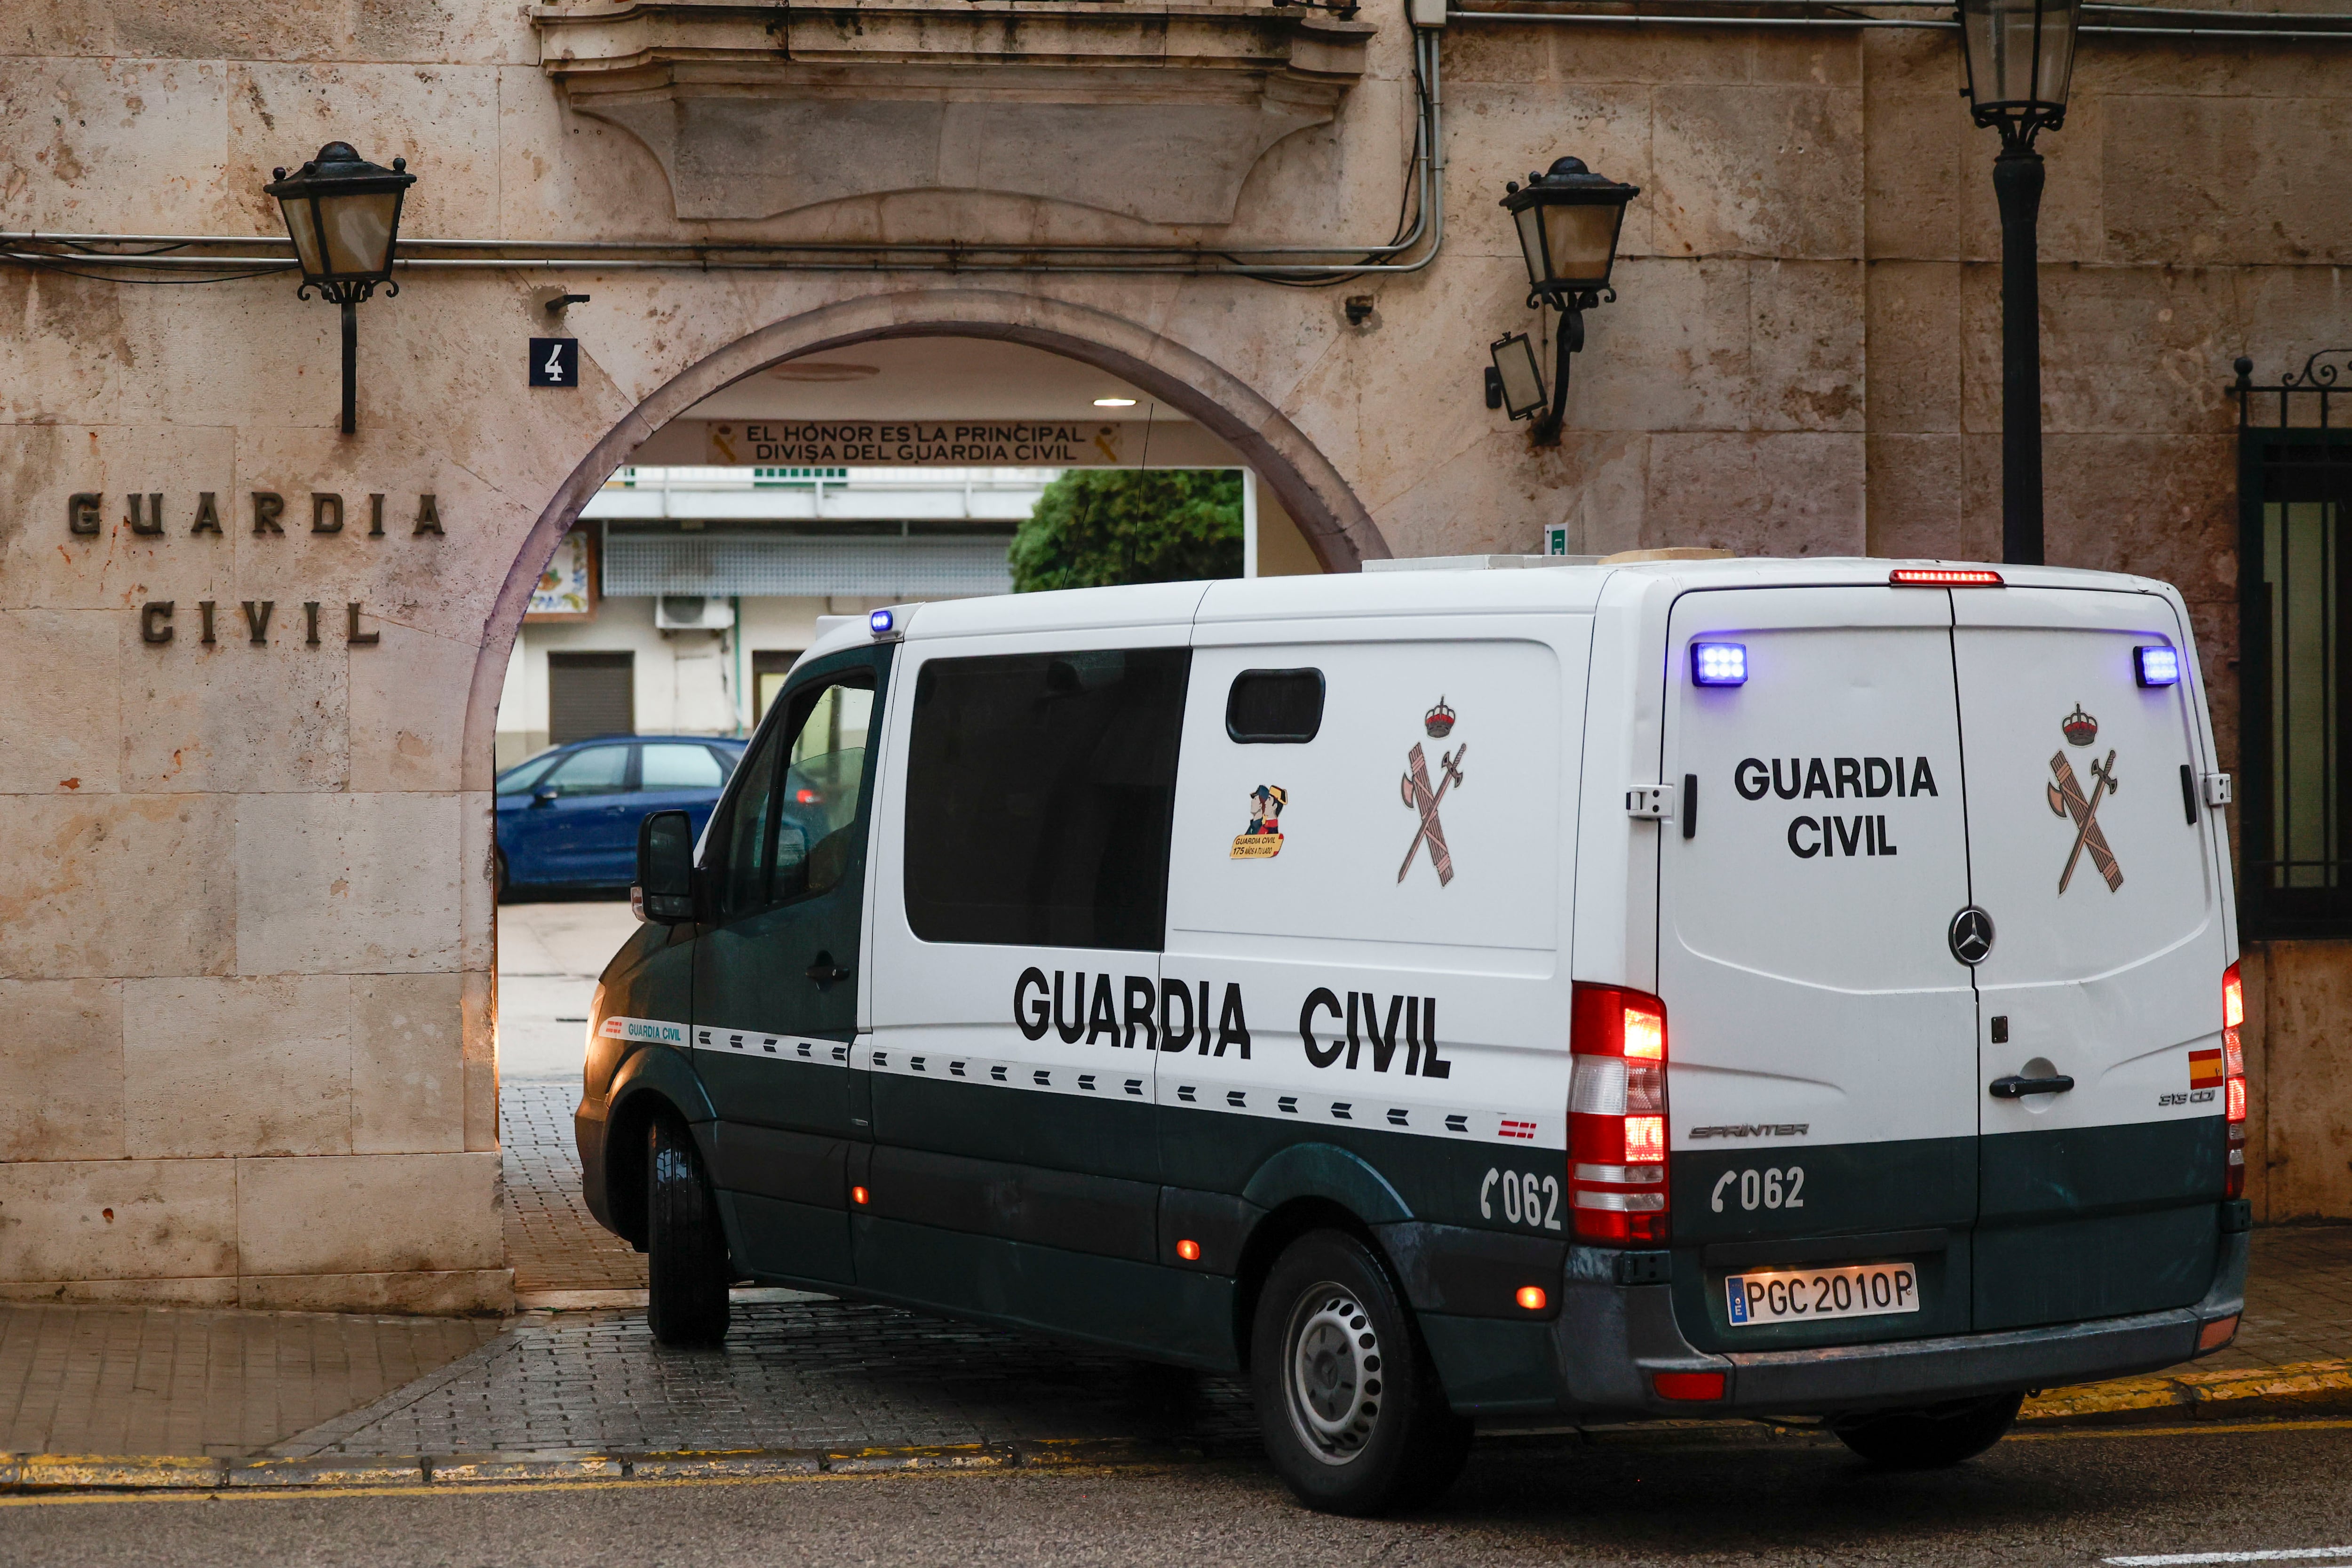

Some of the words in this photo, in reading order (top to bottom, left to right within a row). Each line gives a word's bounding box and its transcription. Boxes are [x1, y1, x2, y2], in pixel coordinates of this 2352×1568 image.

[545, 344, 564, 381] 4
[747, 426, 777, 442] EL
[784, 426, 874, 442] HONOR
[881, 427, 911, 442] ES
[917, 427, 947, 442] LA
[955, 427, 1085, 442] PRINCIPAL
[756, 445, 836, 460] DIVISA
[843, 445, 891, 460] DEL
[898, 445, 1008, 461] GUARDIA
[1015, 445, 1077, 460] CIVIL
[68, 491, 445, 535] GUARDIA
[142, 600, 379, 644] CIVIL
[1734, 756, 1939, 801] GUARDIA
[1788, 815, 1897, 859] CIVIL
[628, 1023, 660, 1038] GUARDIA
[662, 1027, 681, 1041] CIVIL
[1013, 966, 1251, 1060] GUARDIA
[1299, 987, 1451, 1079] CIVIL
[1689, 1123, 1810, 1139] SPRINTER
[1503, 1170, 1561, 1231] 062
[1741, 1166, 1805, 1210] 062
